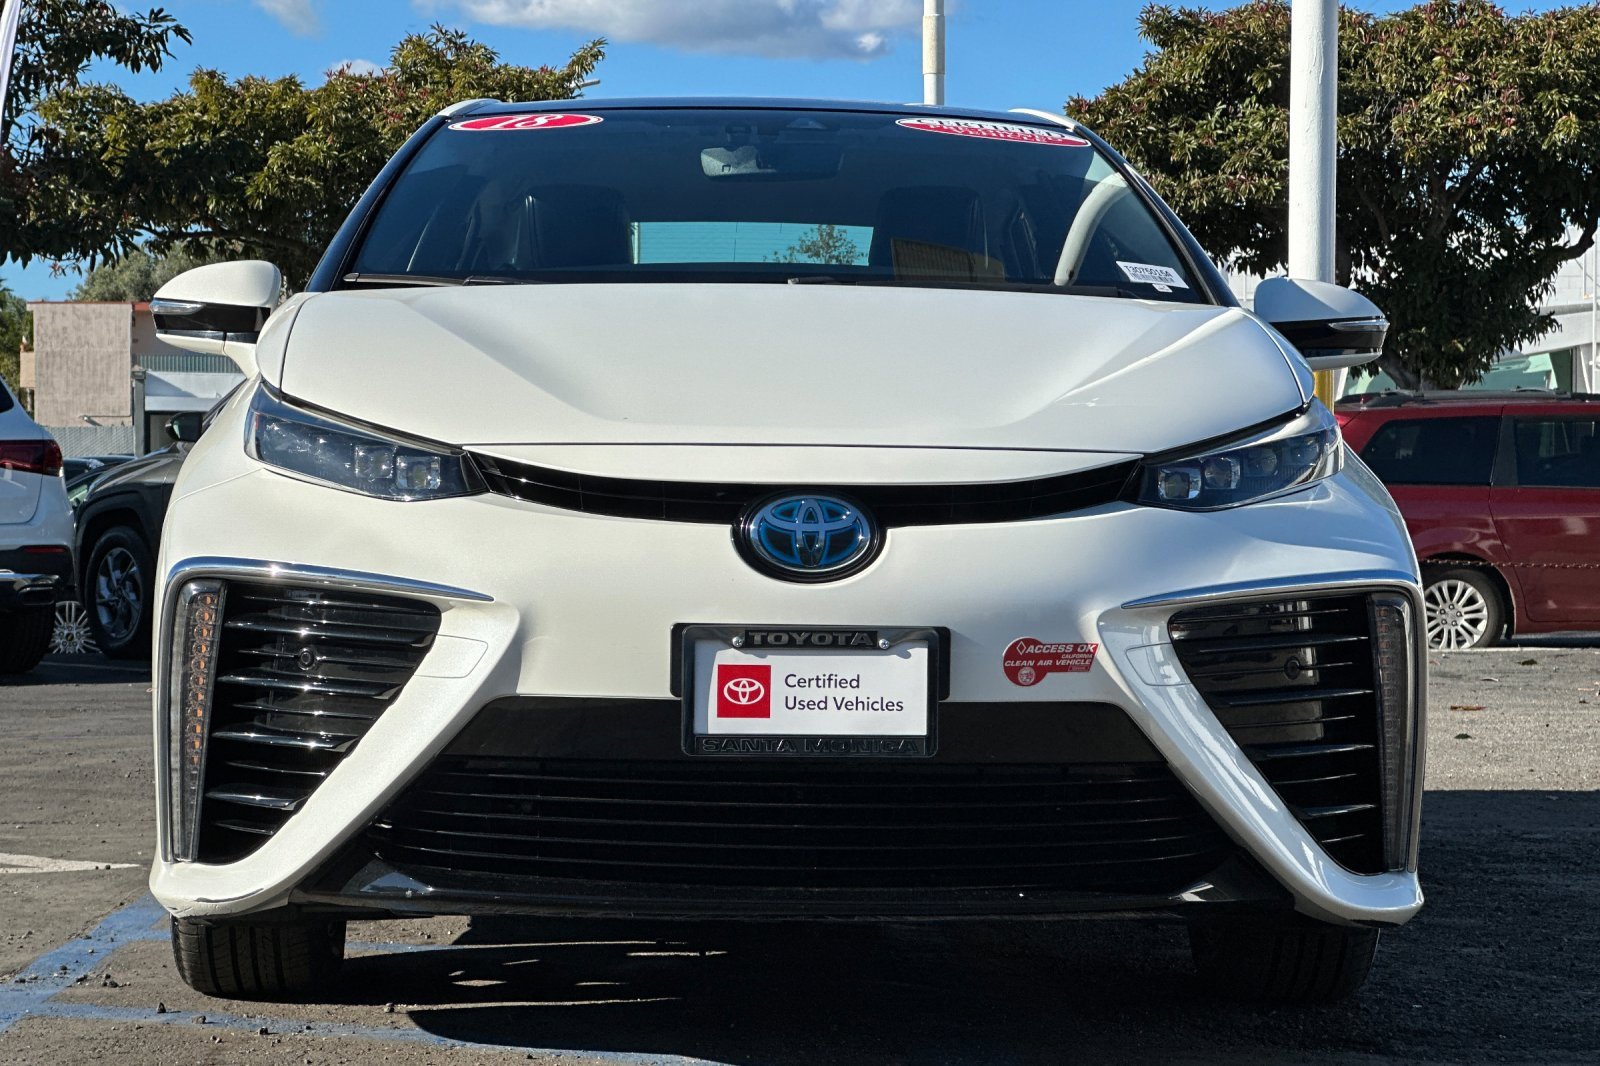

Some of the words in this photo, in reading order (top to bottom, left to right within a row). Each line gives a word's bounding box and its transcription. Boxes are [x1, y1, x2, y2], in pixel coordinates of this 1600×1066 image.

[915, 118, 1066, 138] CERTIFIED
[749, 631, 874, 647] TOYOTA
[1025, 644, 1074, 653] ACCESS
[1077, 644, 1097, 653] OK
[1004, 659, 1035, 667] CLEAN
[1055, 658, 1092, 666] VEHICLE
[784, 673, 860, 689] Certified
[784, 695, 828, 711] Used
[833, 696, 904, 712] Vehicles
[702, 738, 796, 752] SANTA
[804, 738, 918, 753] MONICA
